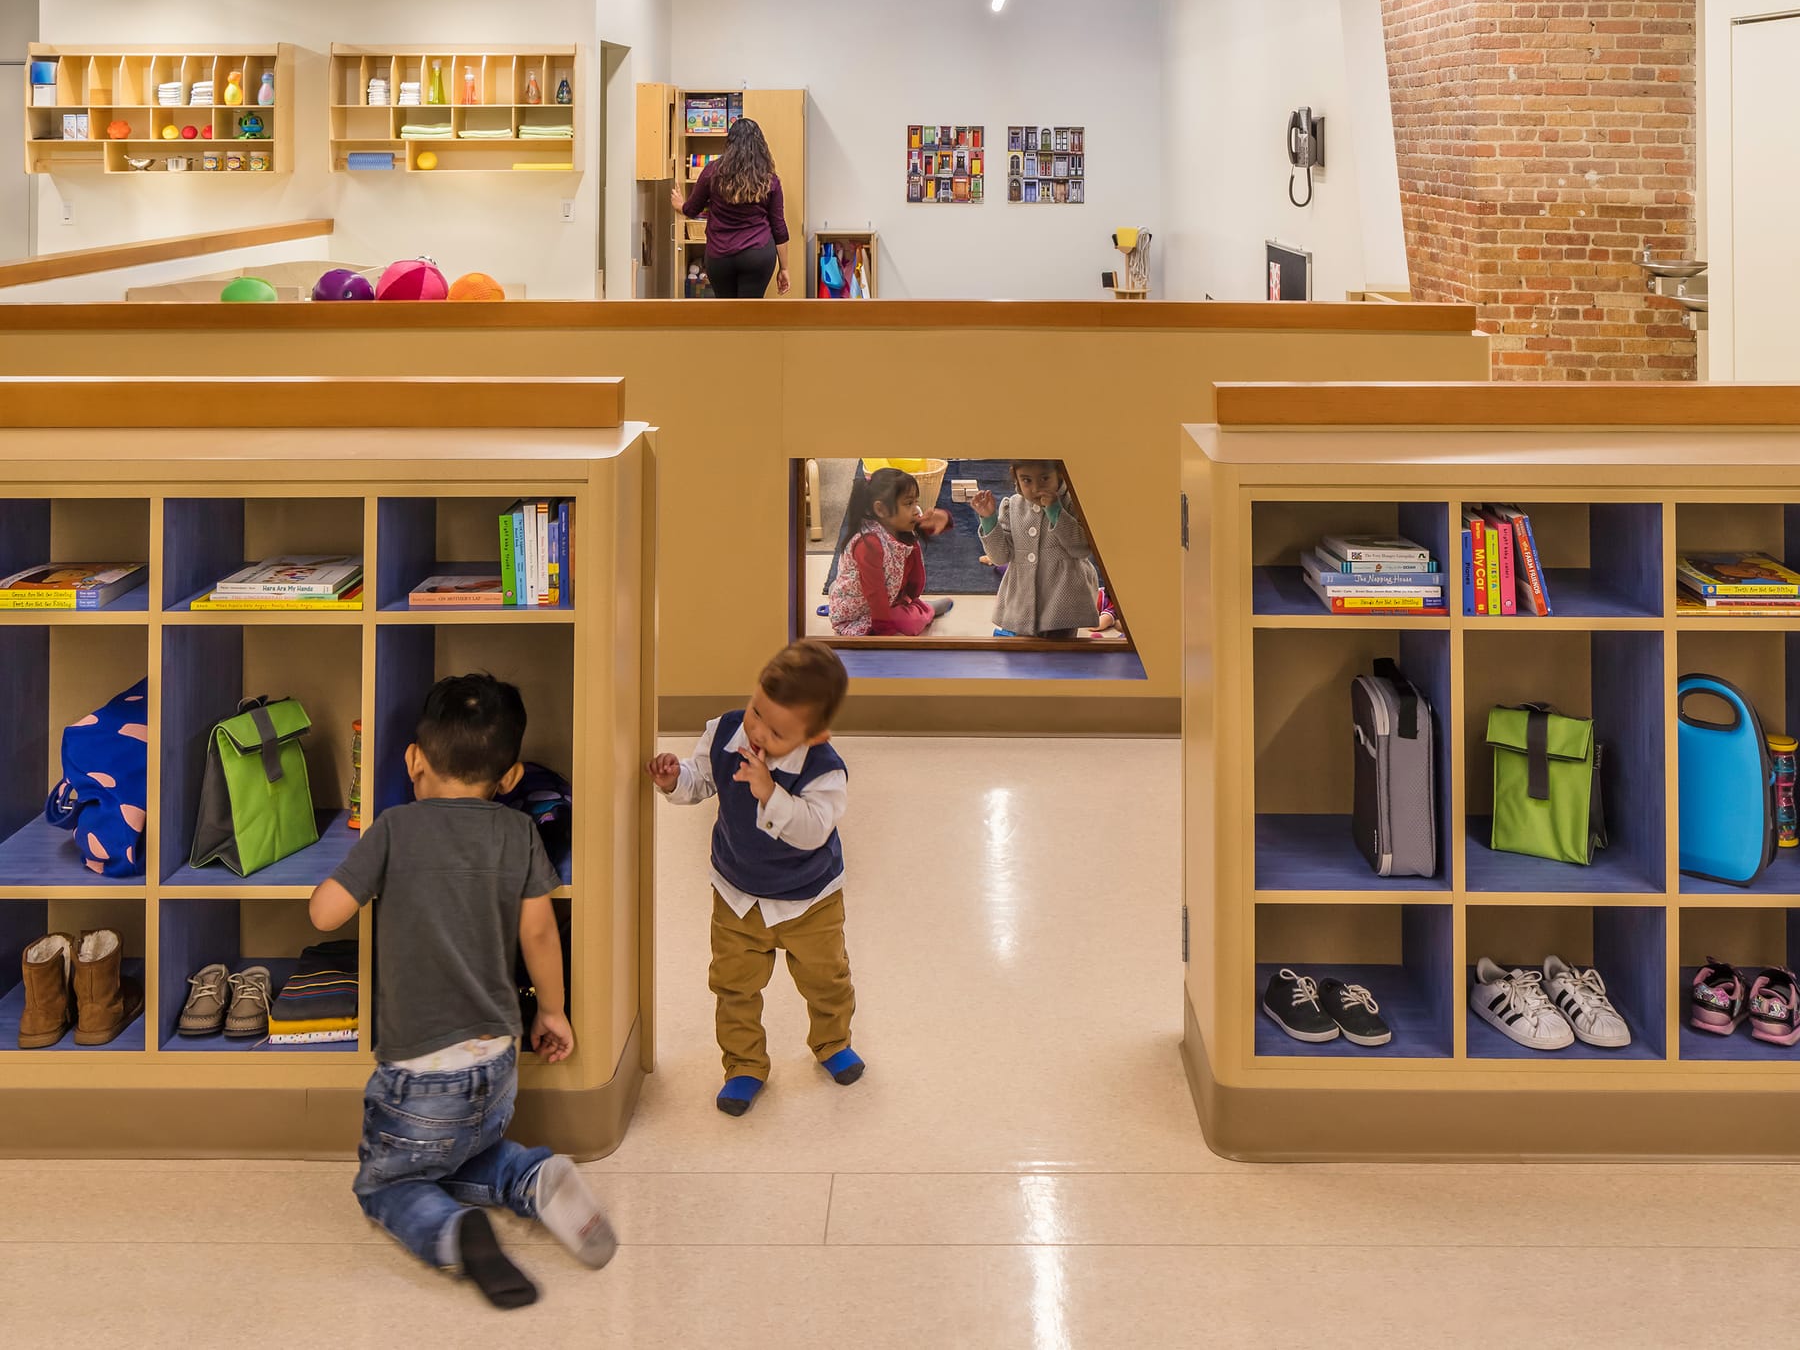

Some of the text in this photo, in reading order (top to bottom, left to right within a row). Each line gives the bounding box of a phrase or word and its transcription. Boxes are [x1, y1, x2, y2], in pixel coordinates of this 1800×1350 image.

[1354, 574, 1412, 584] The Napping House
[1473, 549, 1486, 591] My Car
[1524, 551, 1534, 569] FARM
[1529, 568, 1541, 595] FRIENDS
[287, 585, 296, 593] My
